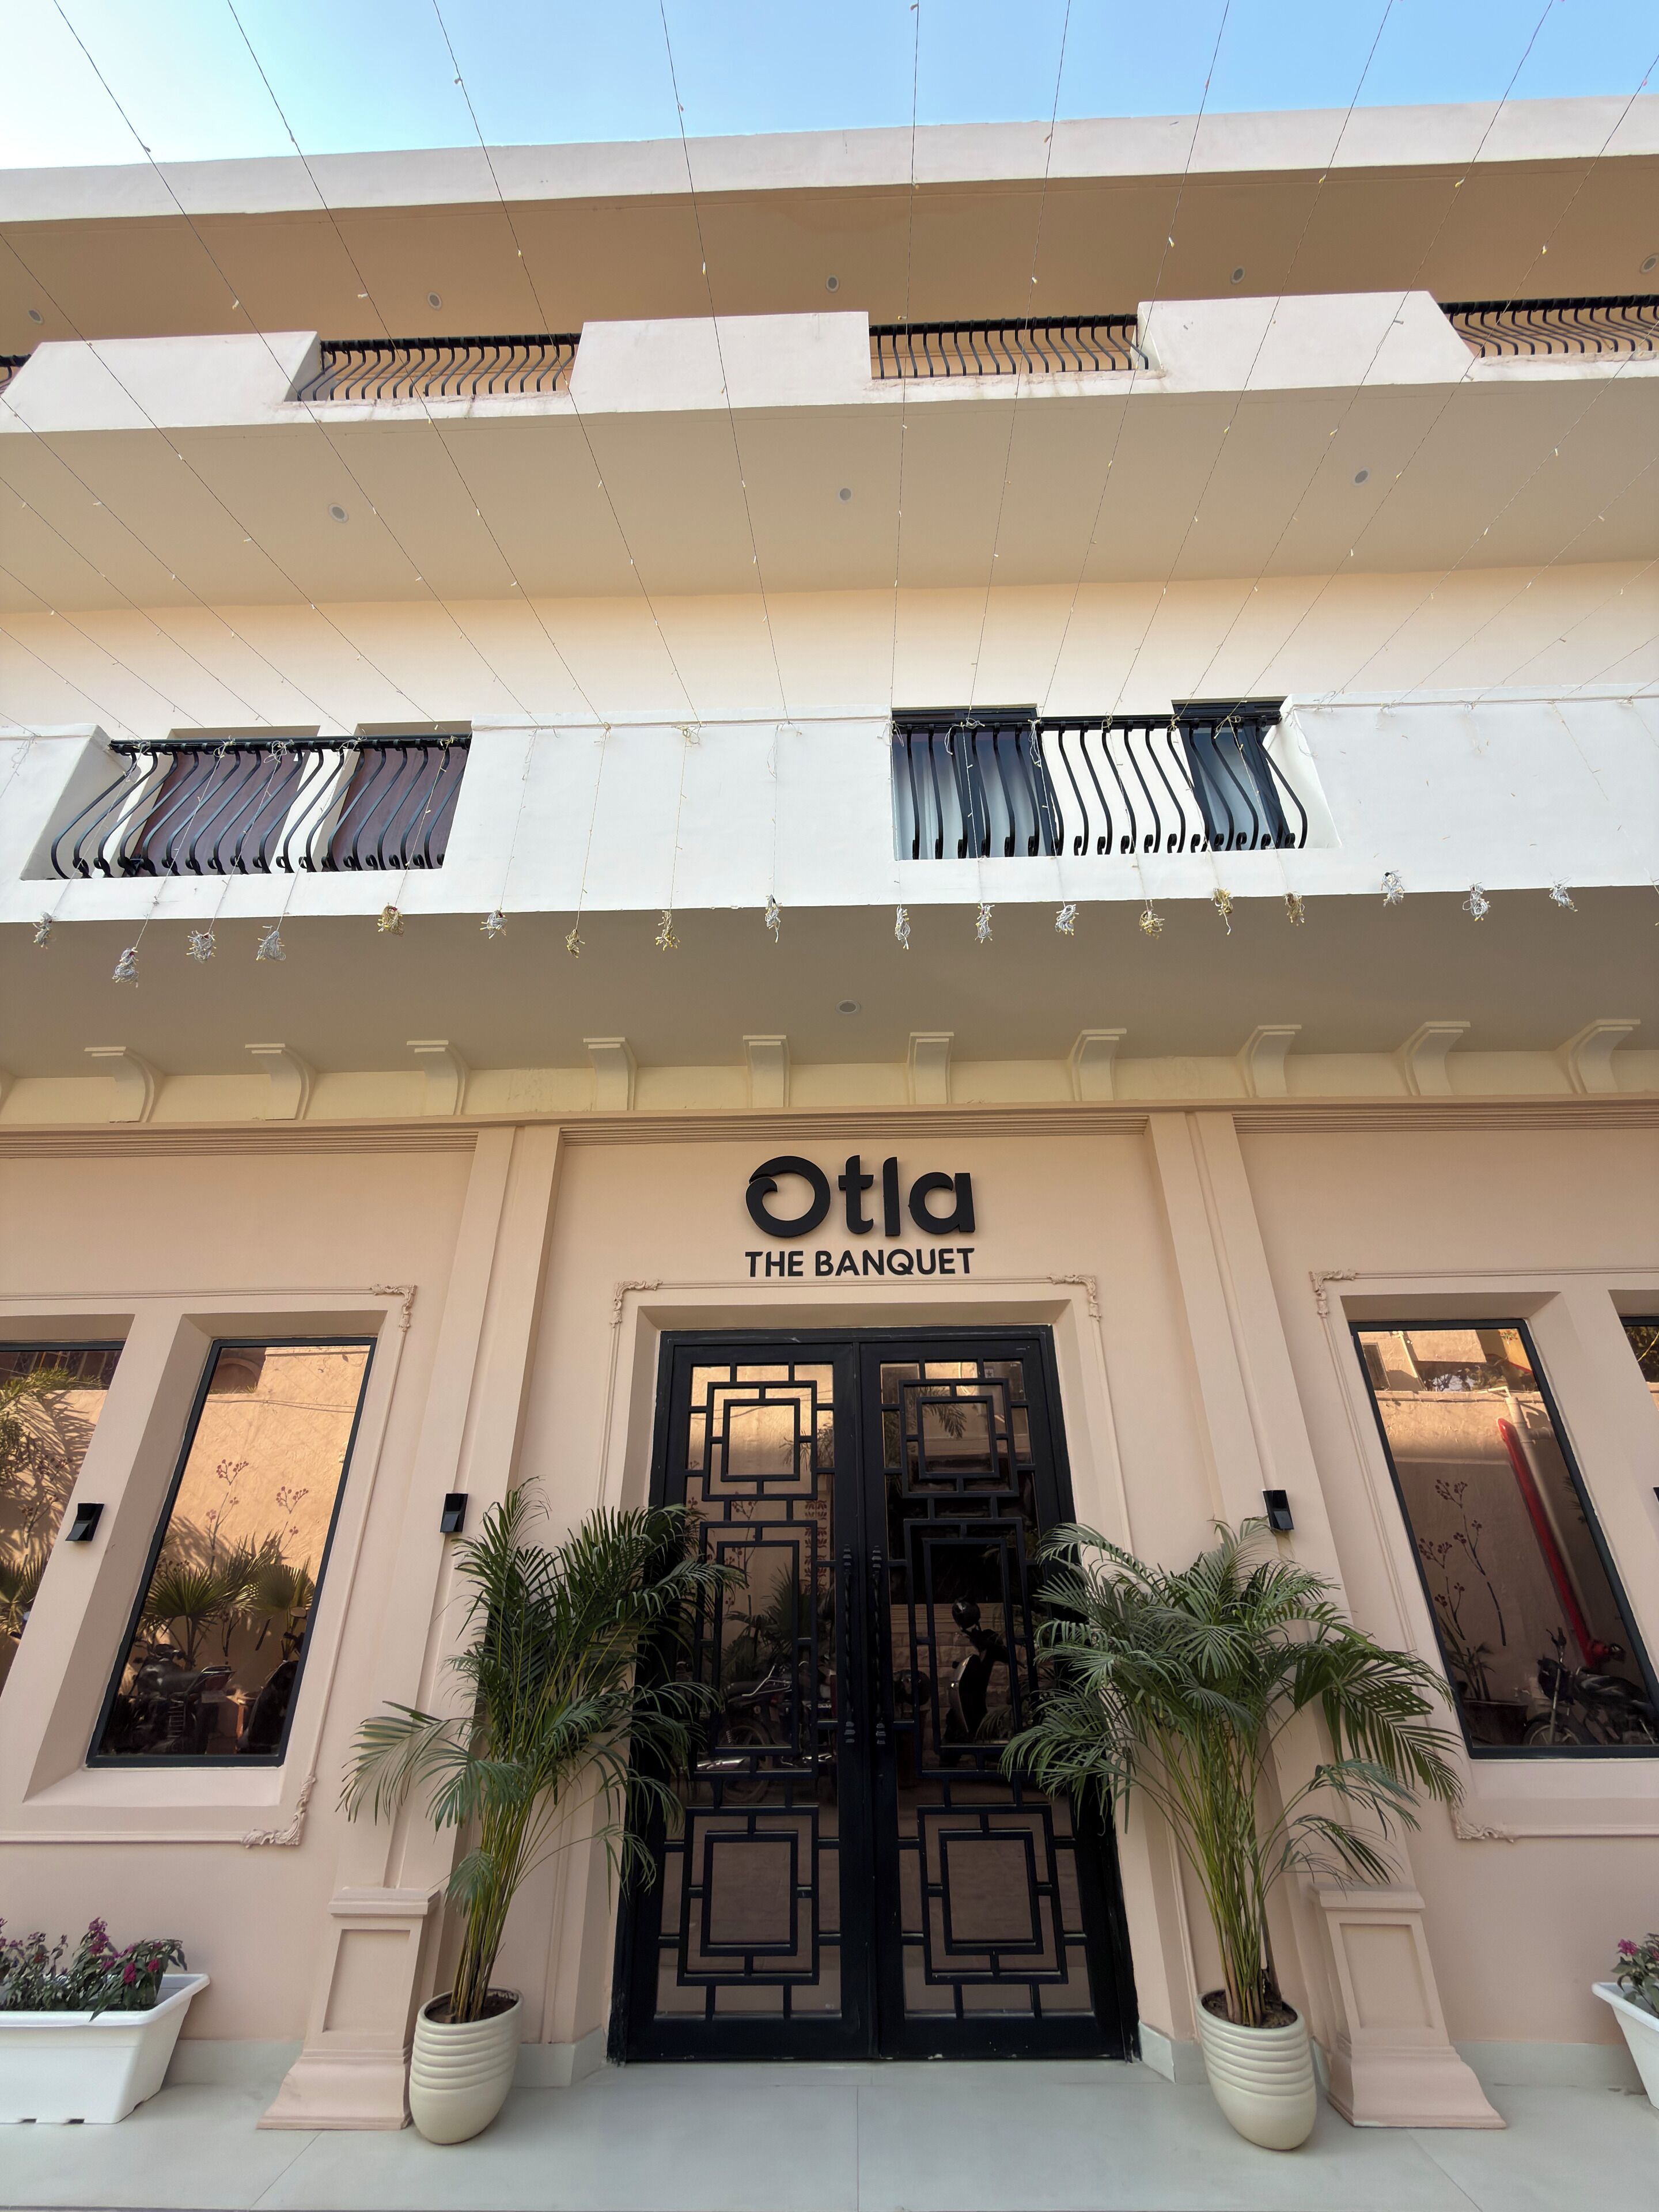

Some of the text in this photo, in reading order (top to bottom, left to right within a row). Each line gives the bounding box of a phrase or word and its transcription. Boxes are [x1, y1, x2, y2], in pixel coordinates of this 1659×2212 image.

[745, 1154, 976, 1238] Otla
[745, 1248, 975, 1278] THE BANQUET
